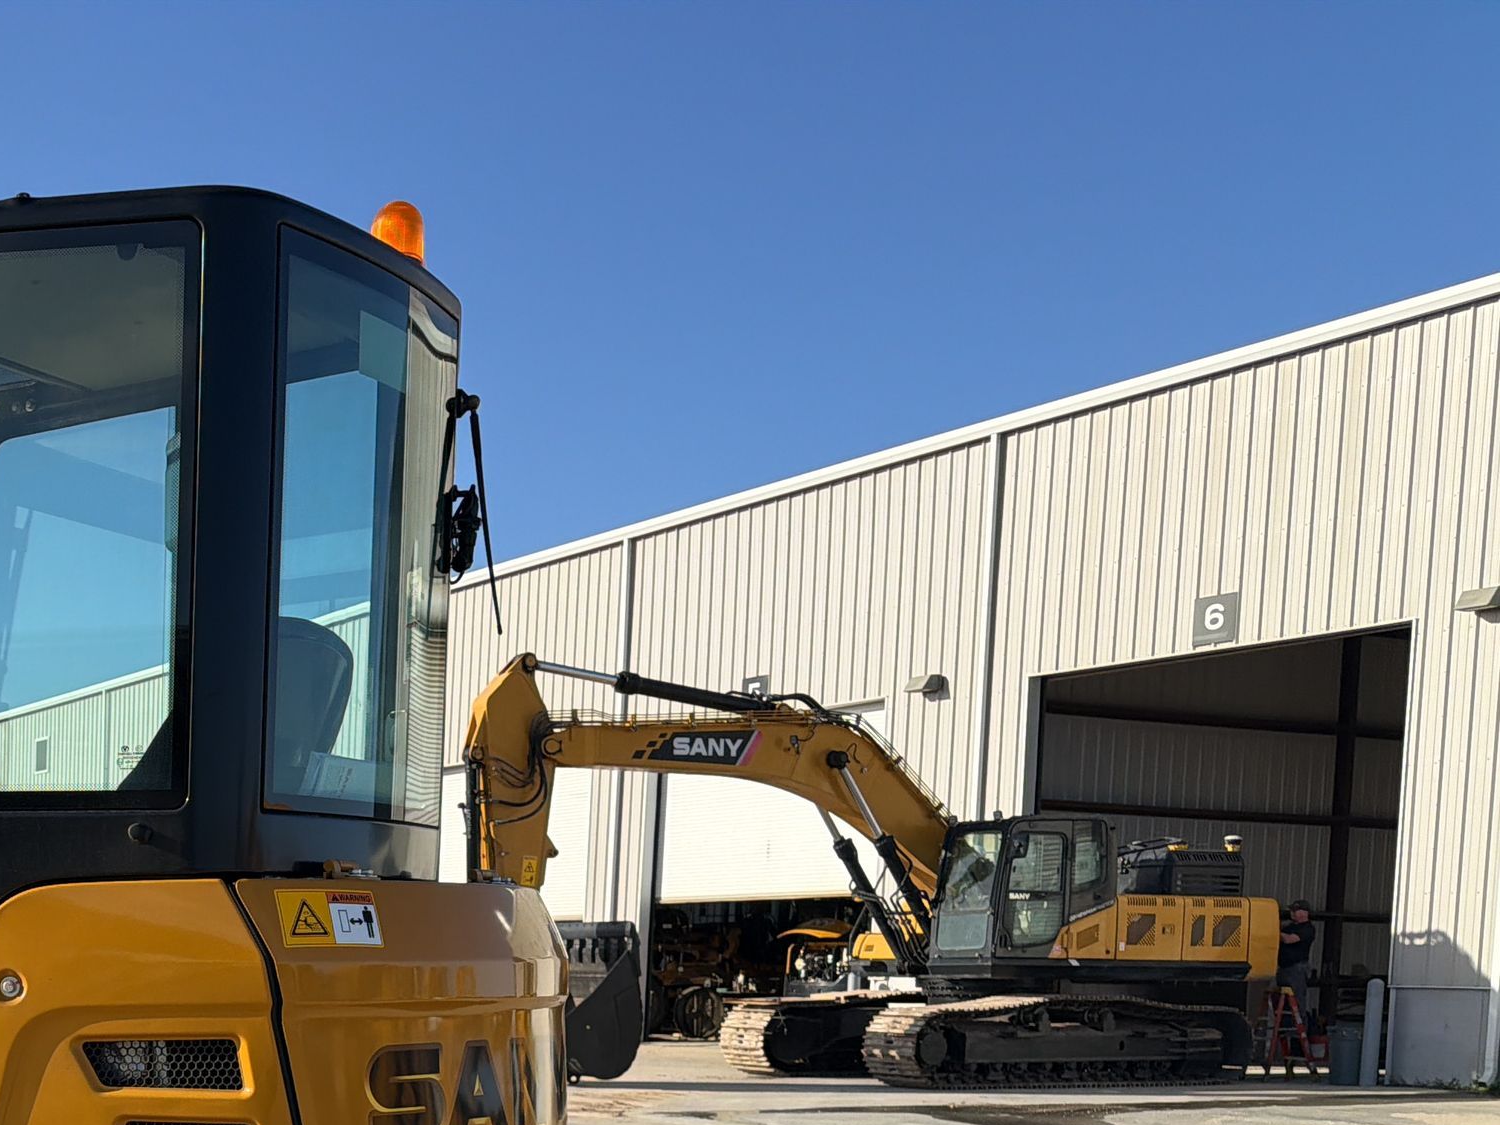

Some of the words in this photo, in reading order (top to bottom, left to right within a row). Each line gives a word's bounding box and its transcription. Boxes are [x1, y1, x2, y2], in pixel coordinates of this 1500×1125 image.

[1204, 603, 1225, 631] 6
[672, 736, 744, 758] SANY
[340, 893, 372, 903] WARNING
